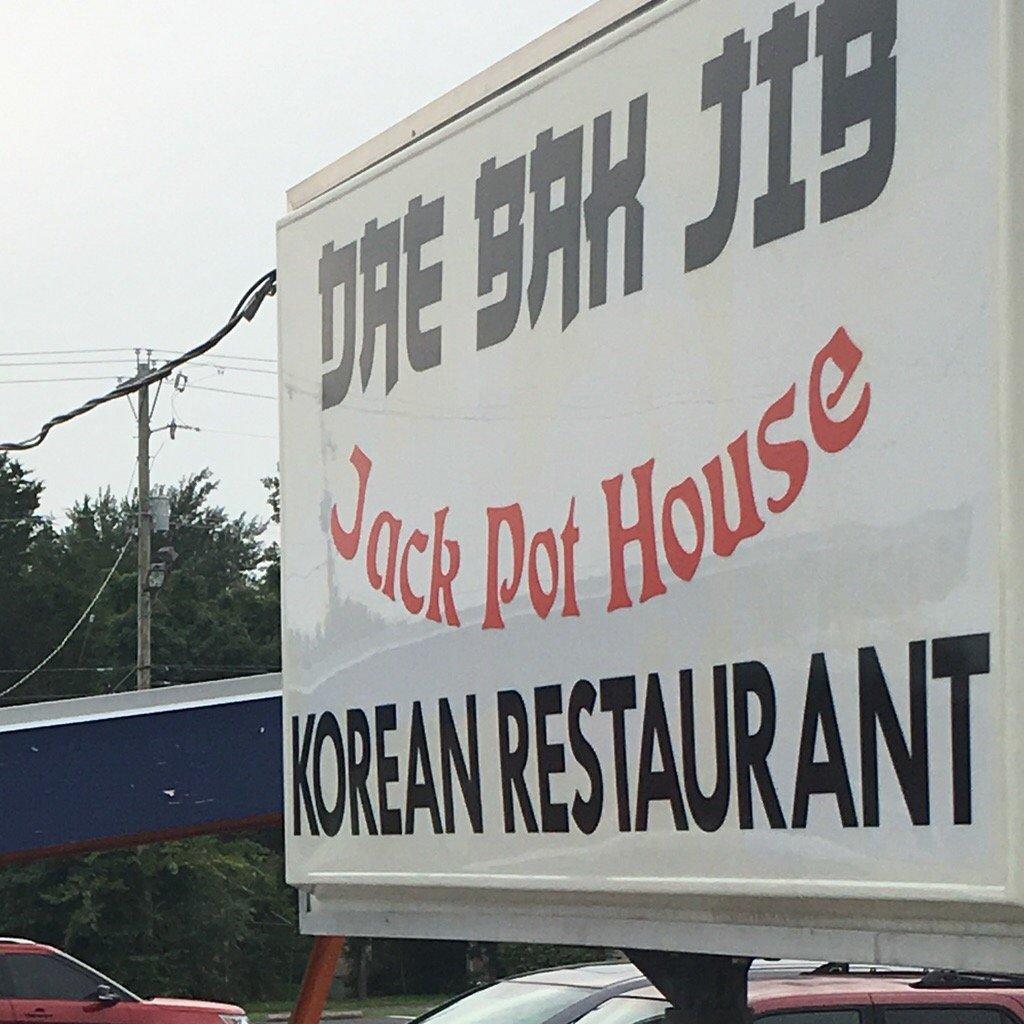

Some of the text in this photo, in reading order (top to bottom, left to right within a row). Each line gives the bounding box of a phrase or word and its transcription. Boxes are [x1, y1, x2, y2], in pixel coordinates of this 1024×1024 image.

[319, 0, 898, 412] DAE BAK JIB
[331, 326, 872, 630] Jack Pot House
[291, 632, 991, 838] KOREAN RESTAURANT
